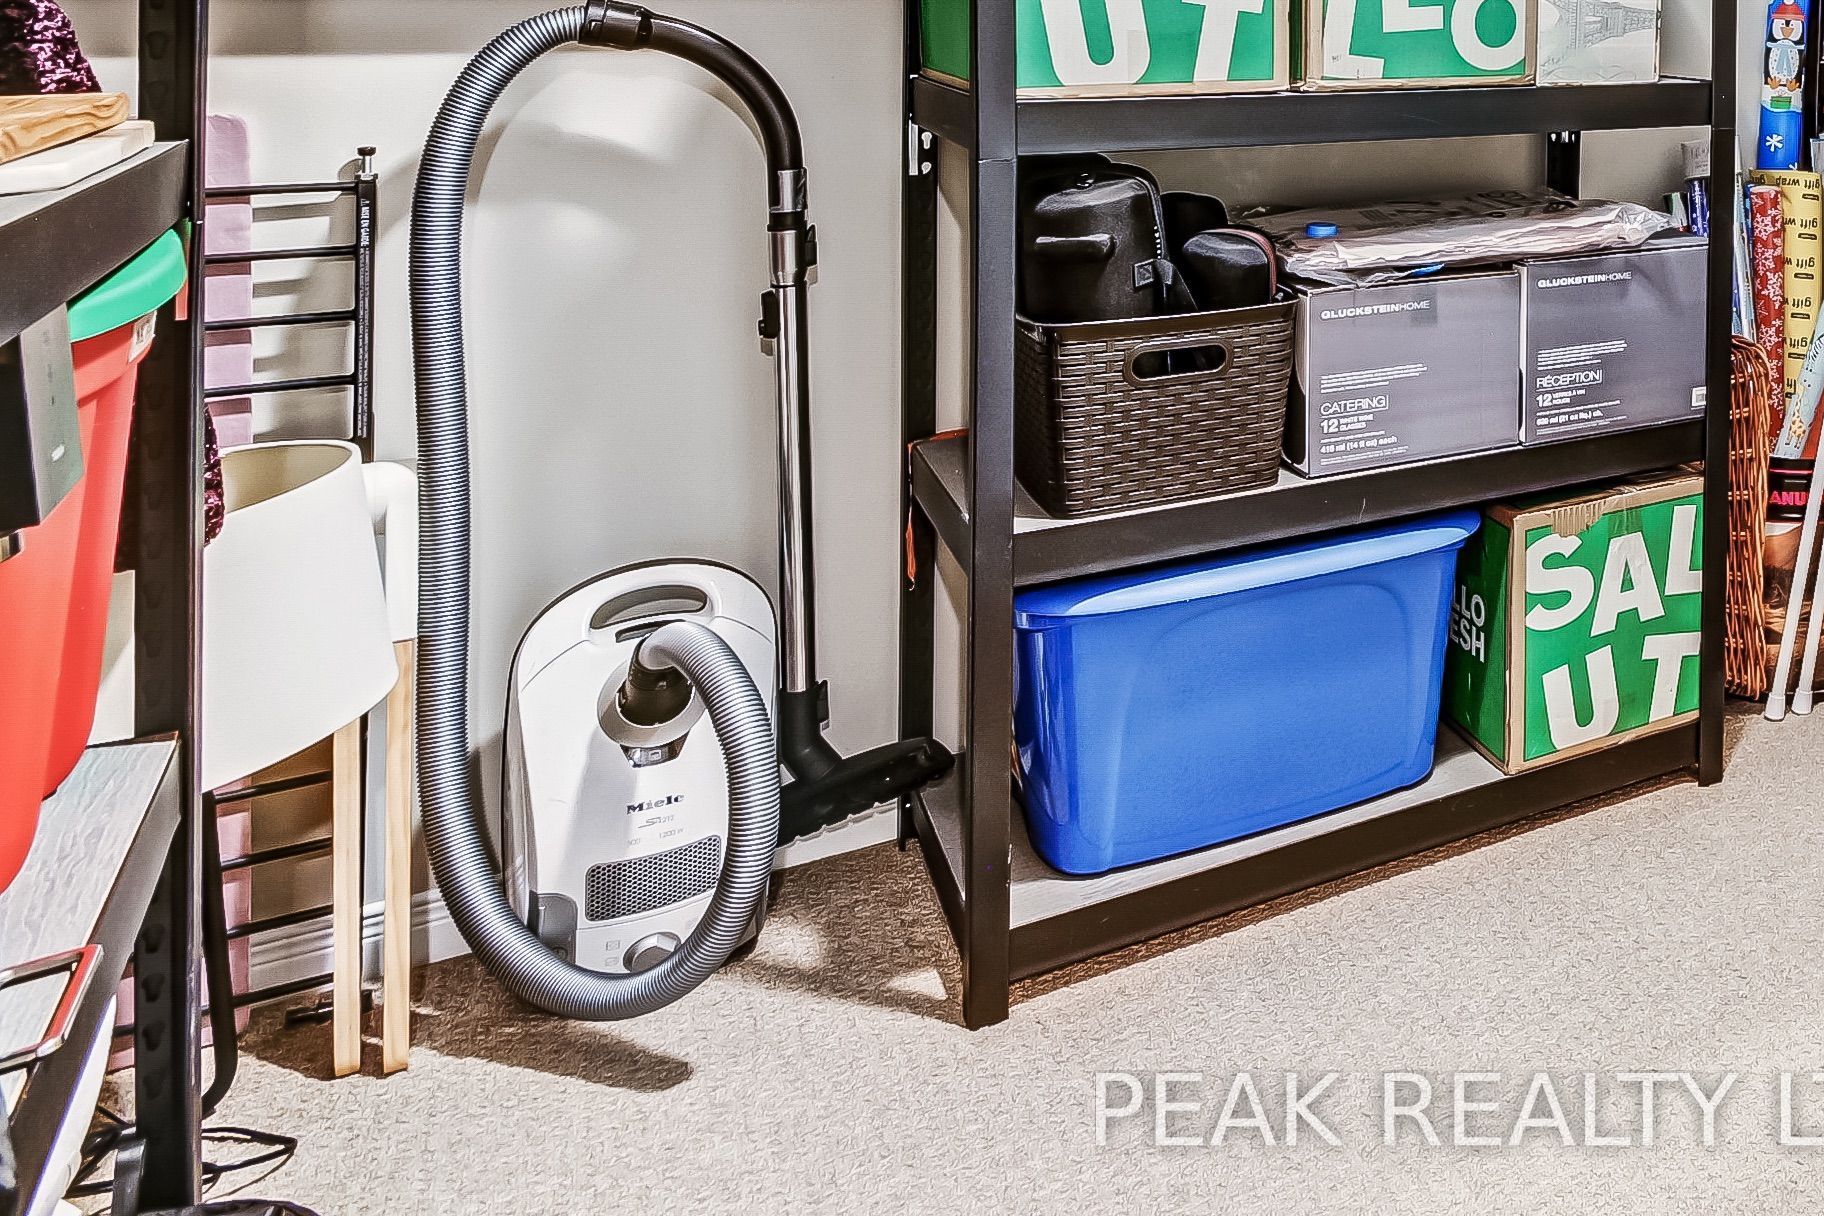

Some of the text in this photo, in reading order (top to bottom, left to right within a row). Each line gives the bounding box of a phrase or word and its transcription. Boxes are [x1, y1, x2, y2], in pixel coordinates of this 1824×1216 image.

[1537, 271, 1633, 289] GLUCKSTEINHOME
[1320, 299, 1431, 320] GLUCKSTEINHOME
[1536, 370, 1601, 389] RÉCEPTION
[1320, 395, 1387, 416] CATERING
[1536, 394, 1553, 408] 12
[1320, 419, 1339, 434] 12
[1378, 435, 1398, 445] each
[625, 793, 685, 816] Miele
